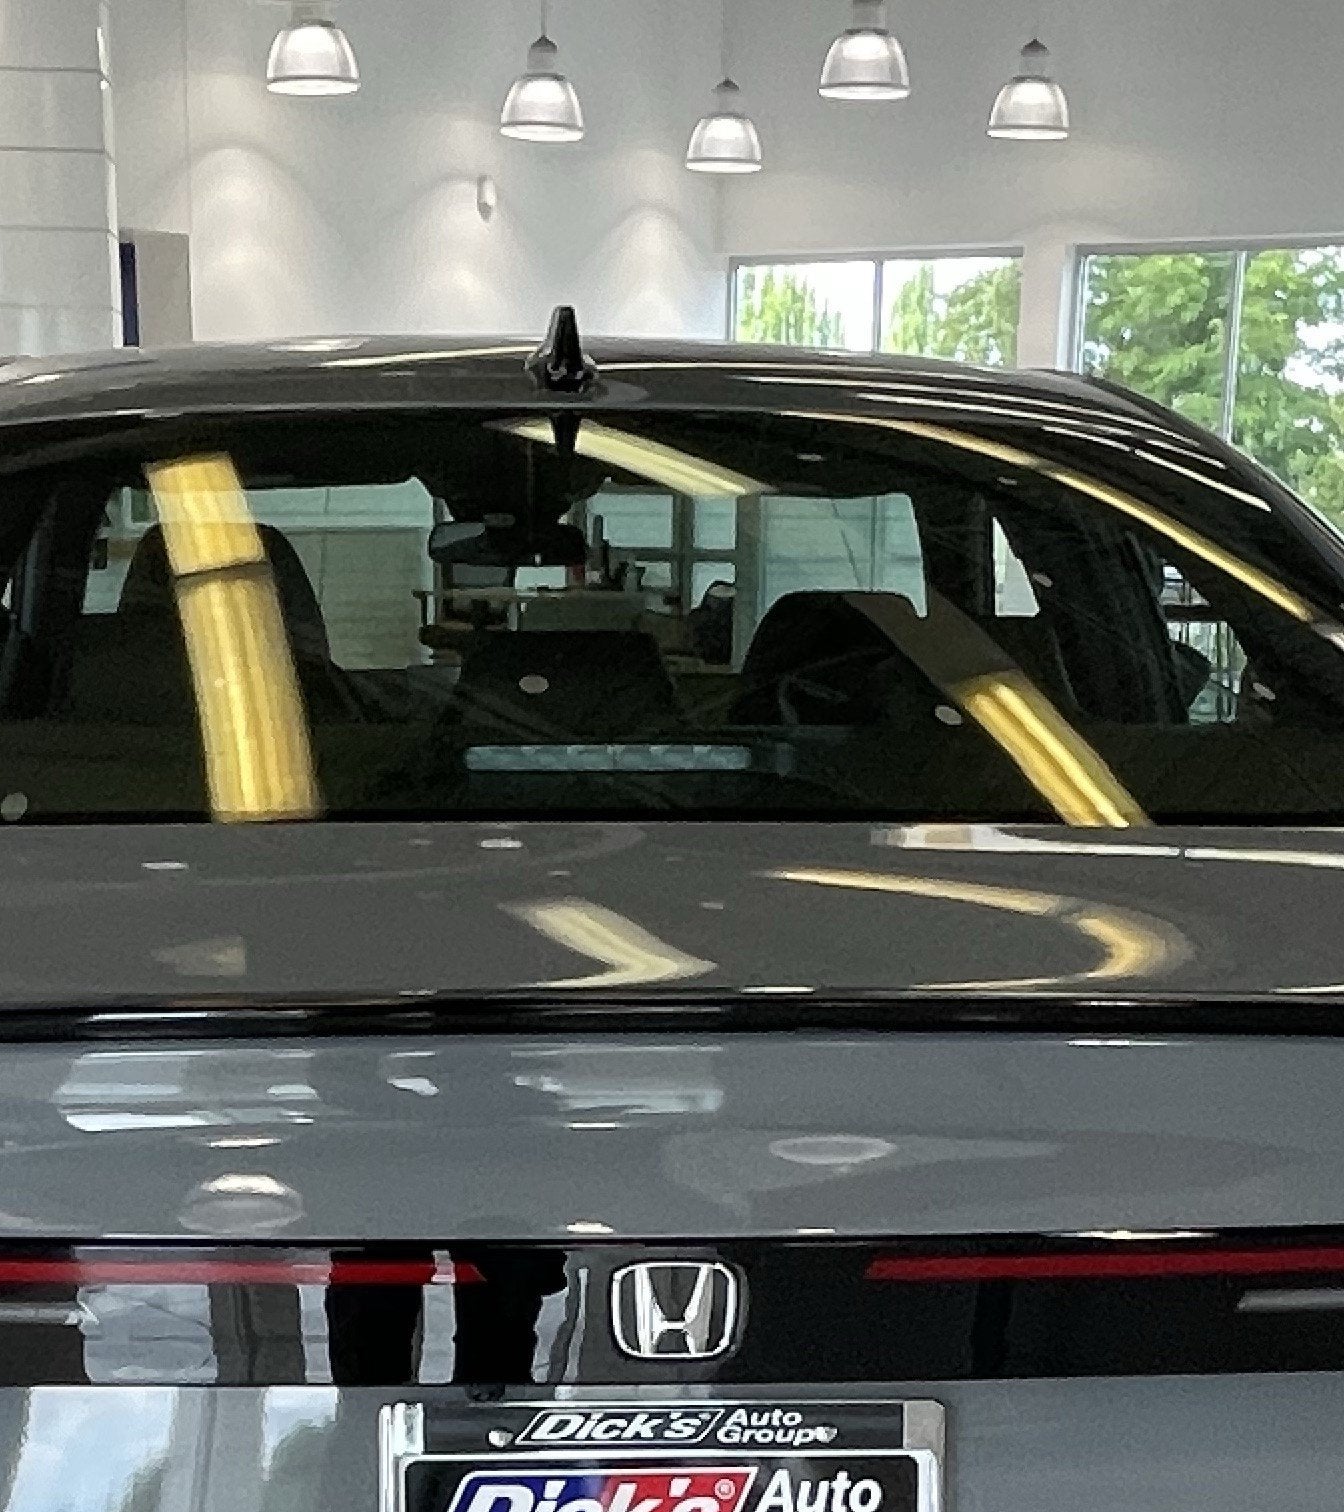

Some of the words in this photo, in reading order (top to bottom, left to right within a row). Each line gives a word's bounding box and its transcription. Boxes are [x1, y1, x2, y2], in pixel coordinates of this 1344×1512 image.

[530, 1410, 702, 1440] Dick's
[726, 1408, 803, 1427] Auto
[716, 1426, 816, 1446] Group
